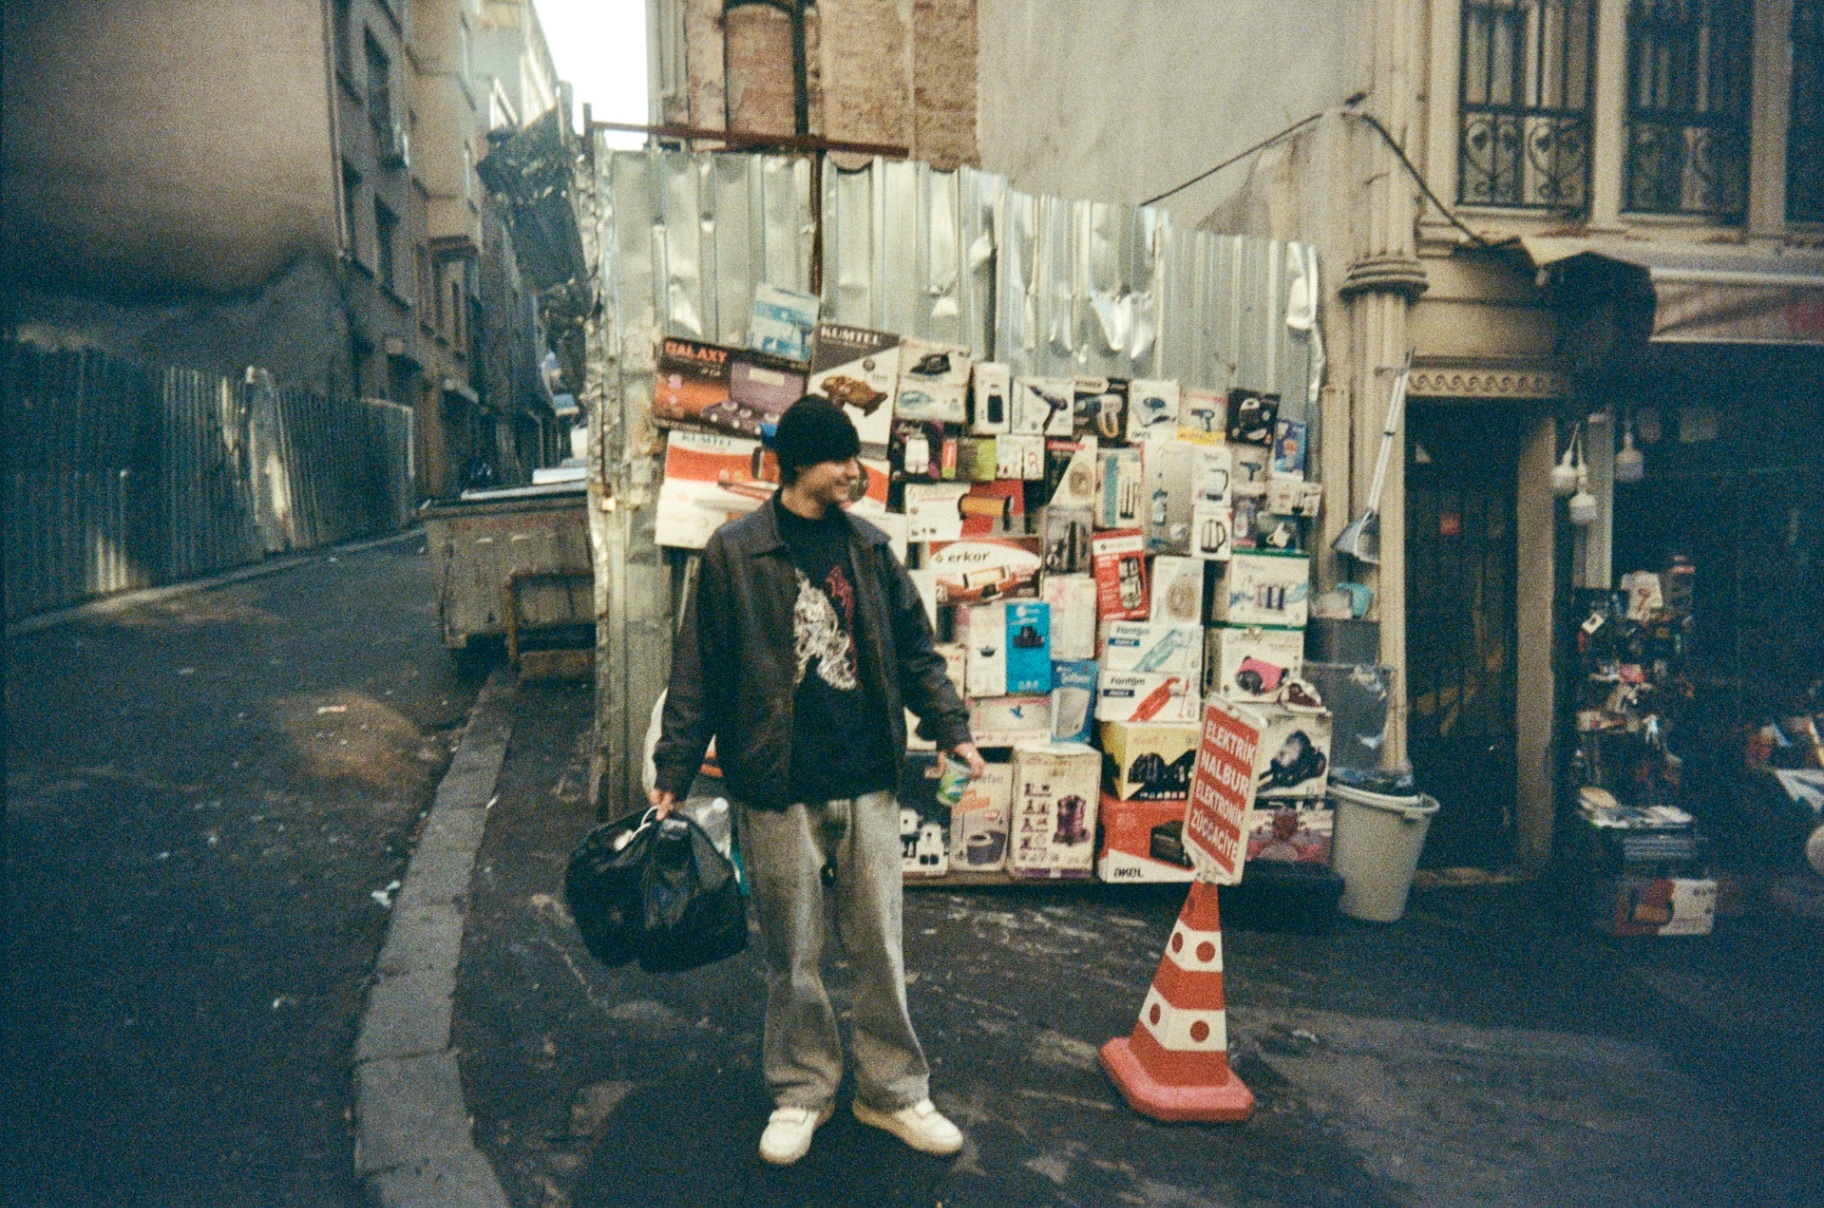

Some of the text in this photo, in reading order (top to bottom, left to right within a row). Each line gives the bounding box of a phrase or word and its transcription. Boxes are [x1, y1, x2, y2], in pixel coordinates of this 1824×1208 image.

[664, 340, 729, 364] GALAXY
[820, 325, 880, 345] KUMTEL
[1205, 720, 1256, 766] ELEKTRİK
[1200, 749, 1249, 798] NALBUR
[1195, 779, 1244, 826] ELEKTRONİK
